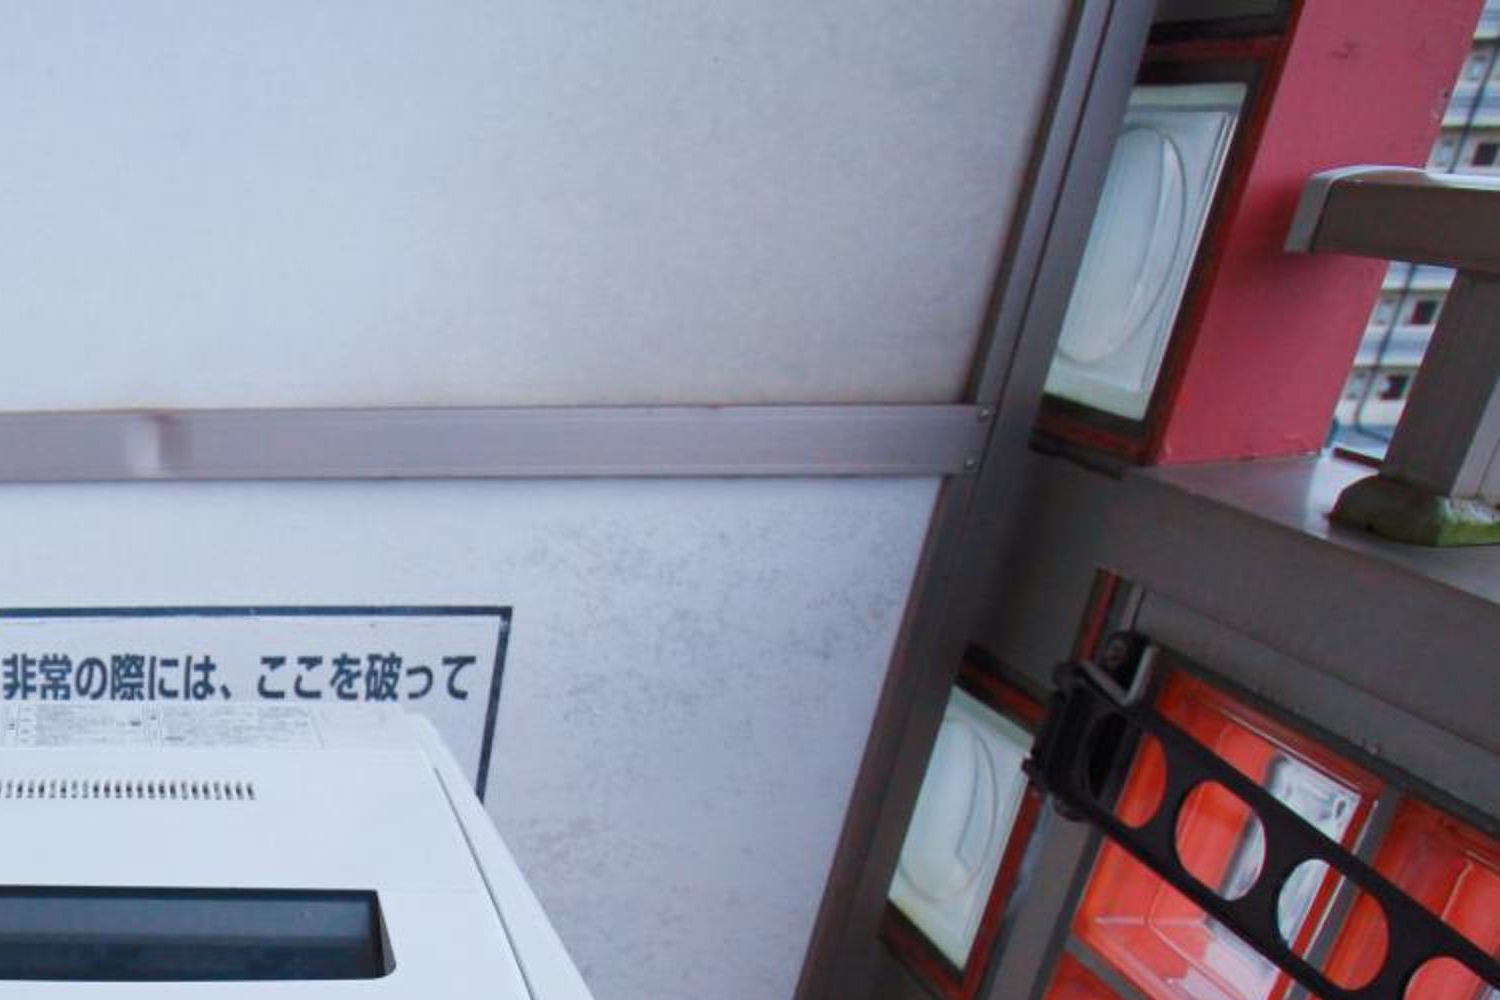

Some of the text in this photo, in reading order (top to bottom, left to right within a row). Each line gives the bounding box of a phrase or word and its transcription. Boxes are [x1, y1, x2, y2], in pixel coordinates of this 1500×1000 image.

[2, 652, 477, 702] 非常の際には、ここを破って
